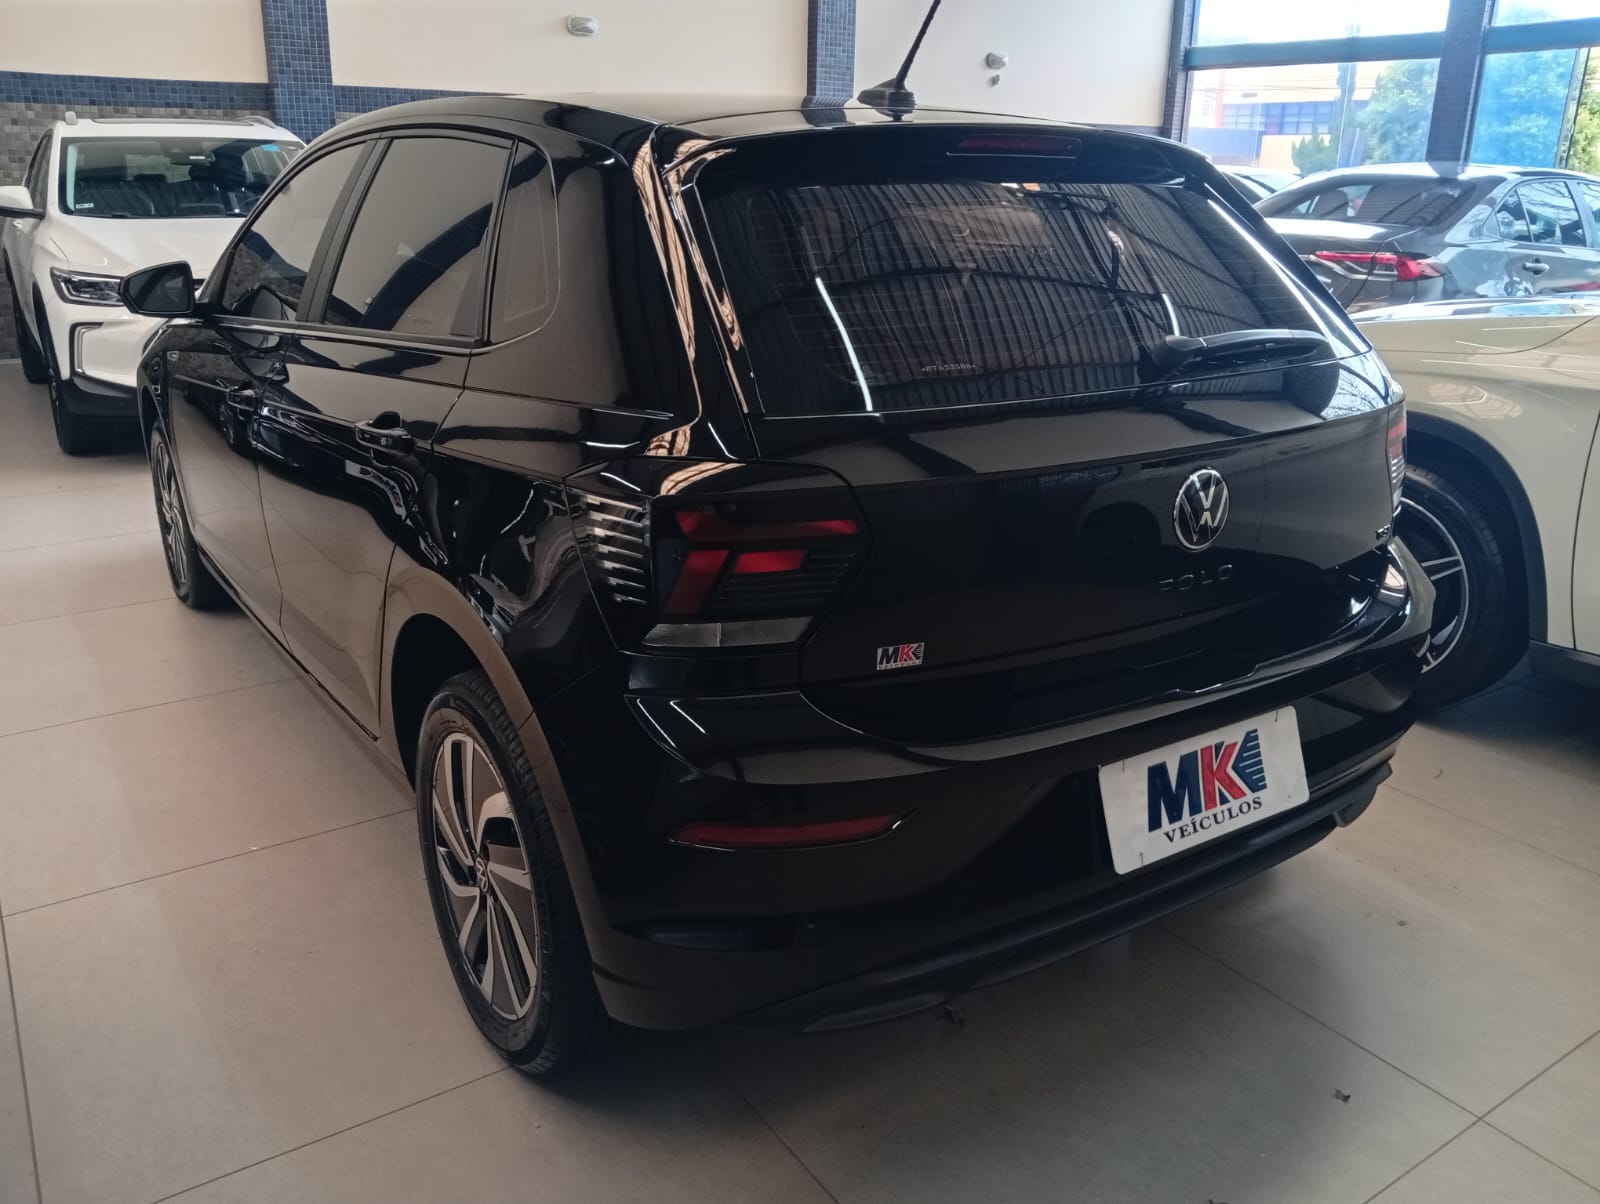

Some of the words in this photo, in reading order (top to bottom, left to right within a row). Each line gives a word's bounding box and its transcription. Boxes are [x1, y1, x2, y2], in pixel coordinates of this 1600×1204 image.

[878, 644, 915, 665] MK
[1147, 740, 1248, 833] MK
[1163, 796, 1263, 843] VEÍCULOS
